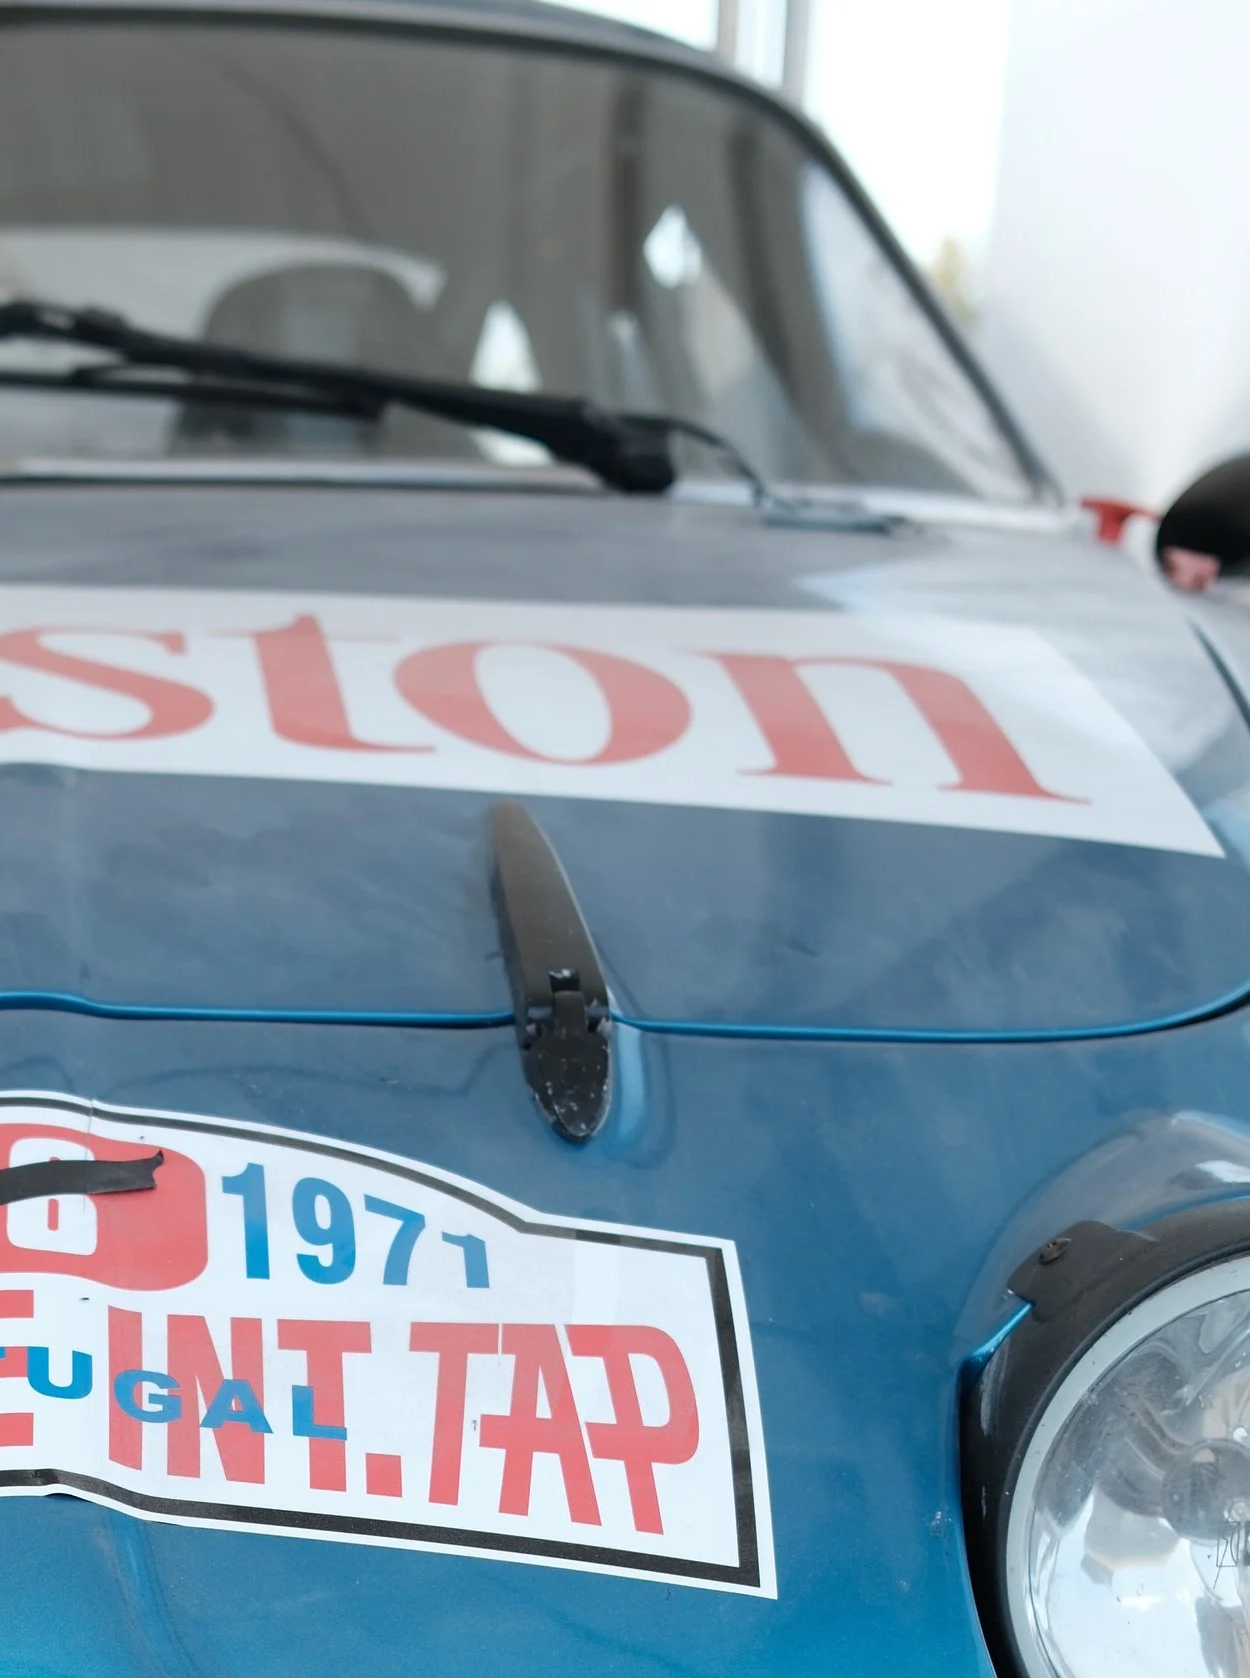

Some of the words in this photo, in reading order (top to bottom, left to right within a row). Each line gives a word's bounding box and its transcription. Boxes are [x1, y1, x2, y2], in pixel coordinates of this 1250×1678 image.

[222, 1162, 491, 1289] 1971
[108, 1306, 403, 1498] INT.
[410, 1322, 700, 1536] TAP
